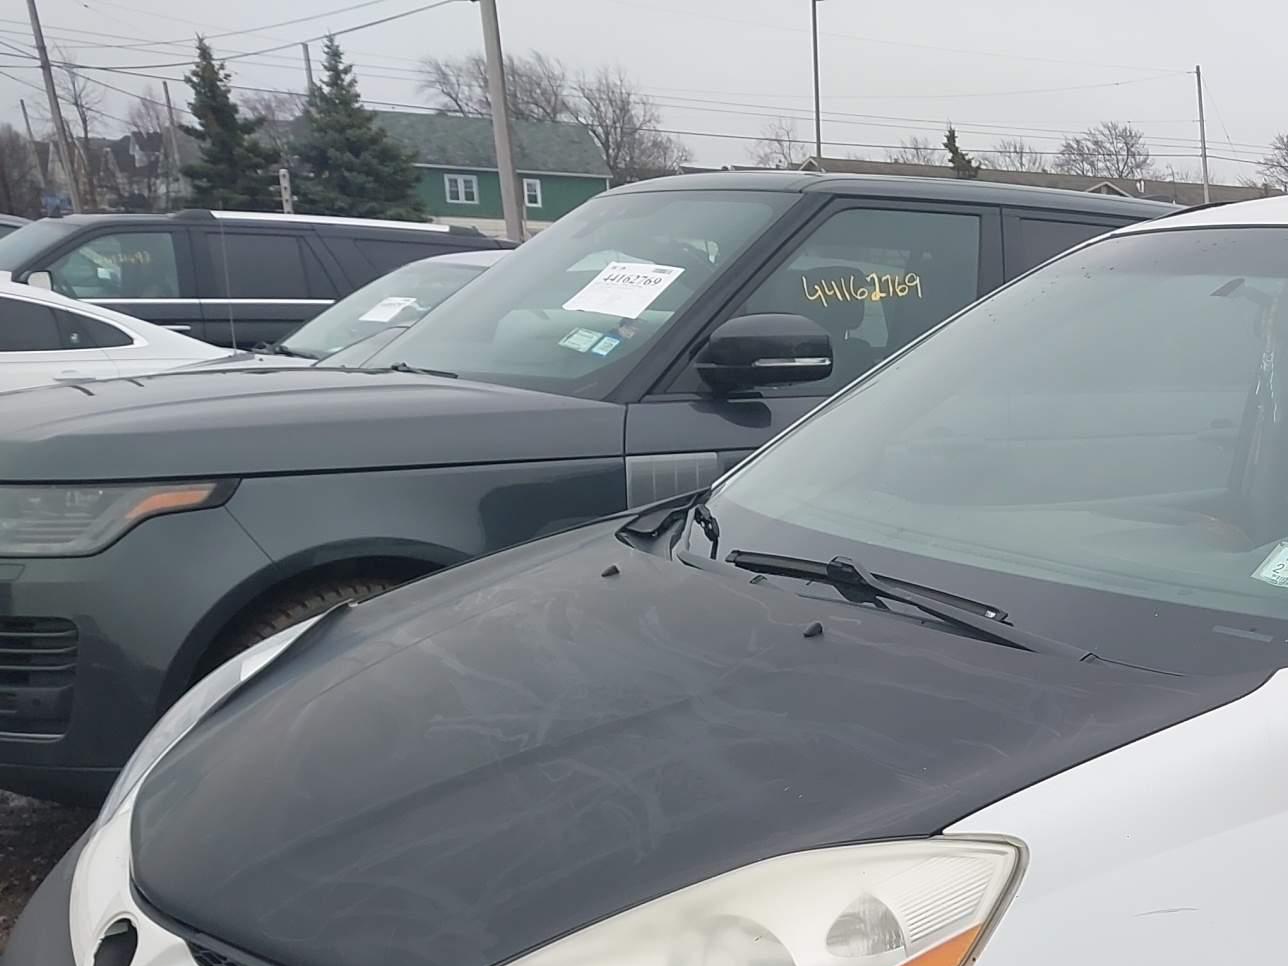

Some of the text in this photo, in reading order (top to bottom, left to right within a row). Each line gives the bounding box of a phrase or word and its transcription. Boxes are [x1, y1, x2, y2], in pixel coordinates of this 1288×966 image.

[603, 273, 663, 286] 44162769
[801, 272, 922, 308] 44162769
[1272, 563, 1286, 574] 2
